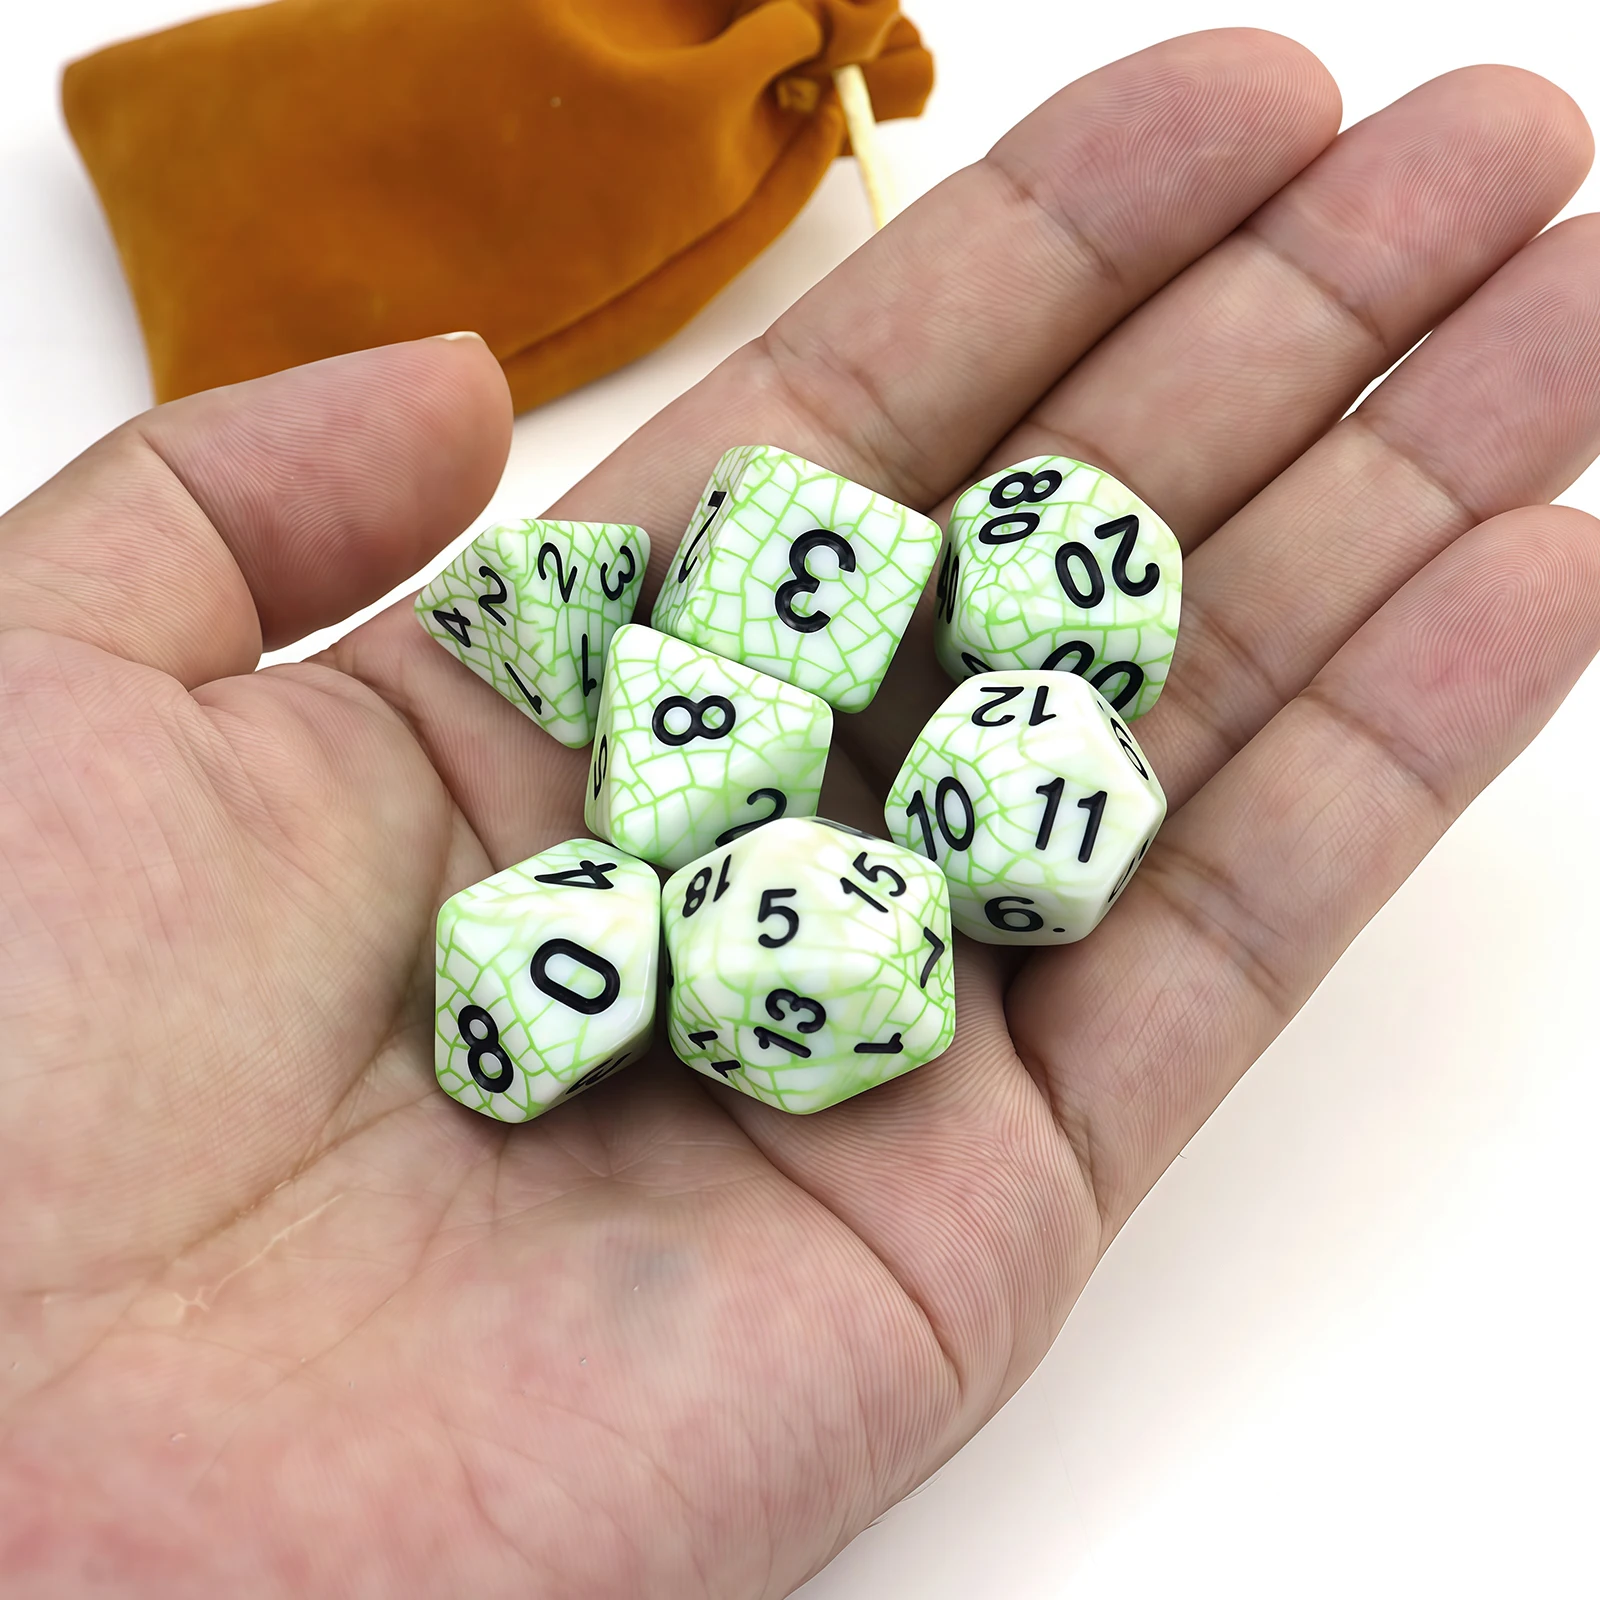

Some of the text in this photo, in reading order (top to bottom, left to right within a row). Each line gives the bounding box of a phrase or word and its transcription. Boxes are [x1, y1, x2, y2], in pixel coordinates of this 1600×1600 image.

[978, 469, 1063, 545] 80
[537, 542, 578, 604] 2
[599, 545, 636, 602] 3
[774, 528, 857, 634] 3
[1054, 514, 1160, 609] 20
[477, 565, 508, 627] 2
[432, 607, 472, 649] 4
[503, 661, 543, 716] 1
[581, 632, 598, 698] 1
[651, 695, 737, 747] 8
[971, 685, 1057, 727] 12
[905, 776, 976, 862] 10
[1035, 776, 1108, 864] 11
[533, 860, 618, 890] 4
[682, 854, 732, 918] 18
[839, 851, 907, 913] 15
[757, 888, 800, 949] 5
[530, 938, 621, 1015] 0
[919, 926, 945, 989] 7
[457, 1004, 514, 1094] 8
[753, 988, 827, 1059] 13
[853, 1032, 904, 1055] 1
